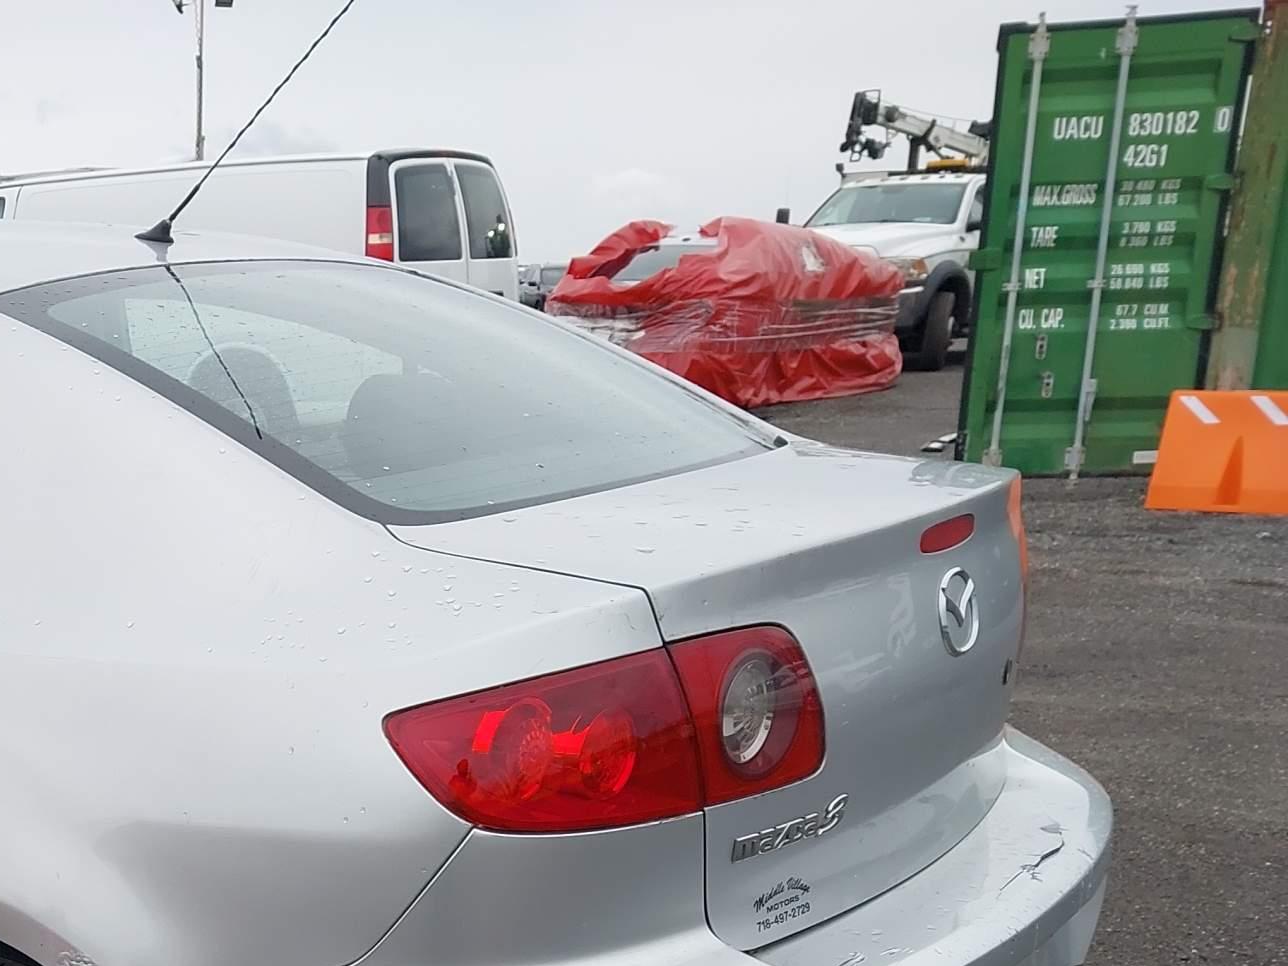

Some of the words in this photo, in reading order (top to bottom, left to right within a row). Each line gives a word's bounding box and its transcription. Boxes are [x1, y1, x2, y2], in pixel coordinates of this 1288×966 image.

[1053, 115, 1105, 140] UACU
[1128, 110, 1200, 136] 830182
[1123, 143, 1169, 167] 42G1
[1158, 193, 1178, 205] LBS
[1030, 226, 1059, 247] TARE
[1024, 267, 1047, 289] NET
[1149, 276, 1170, 288] LBS
[1018, 308, 1036, 329] CU.
[1041, 307, 1065, 328] CAP.
[753, 882, 784, 912] Middle
[786, 877, 811, 895] Village
[766, 895, 800, 913] MOTORS
[757, 902, 811, 932] 718-497-2729
